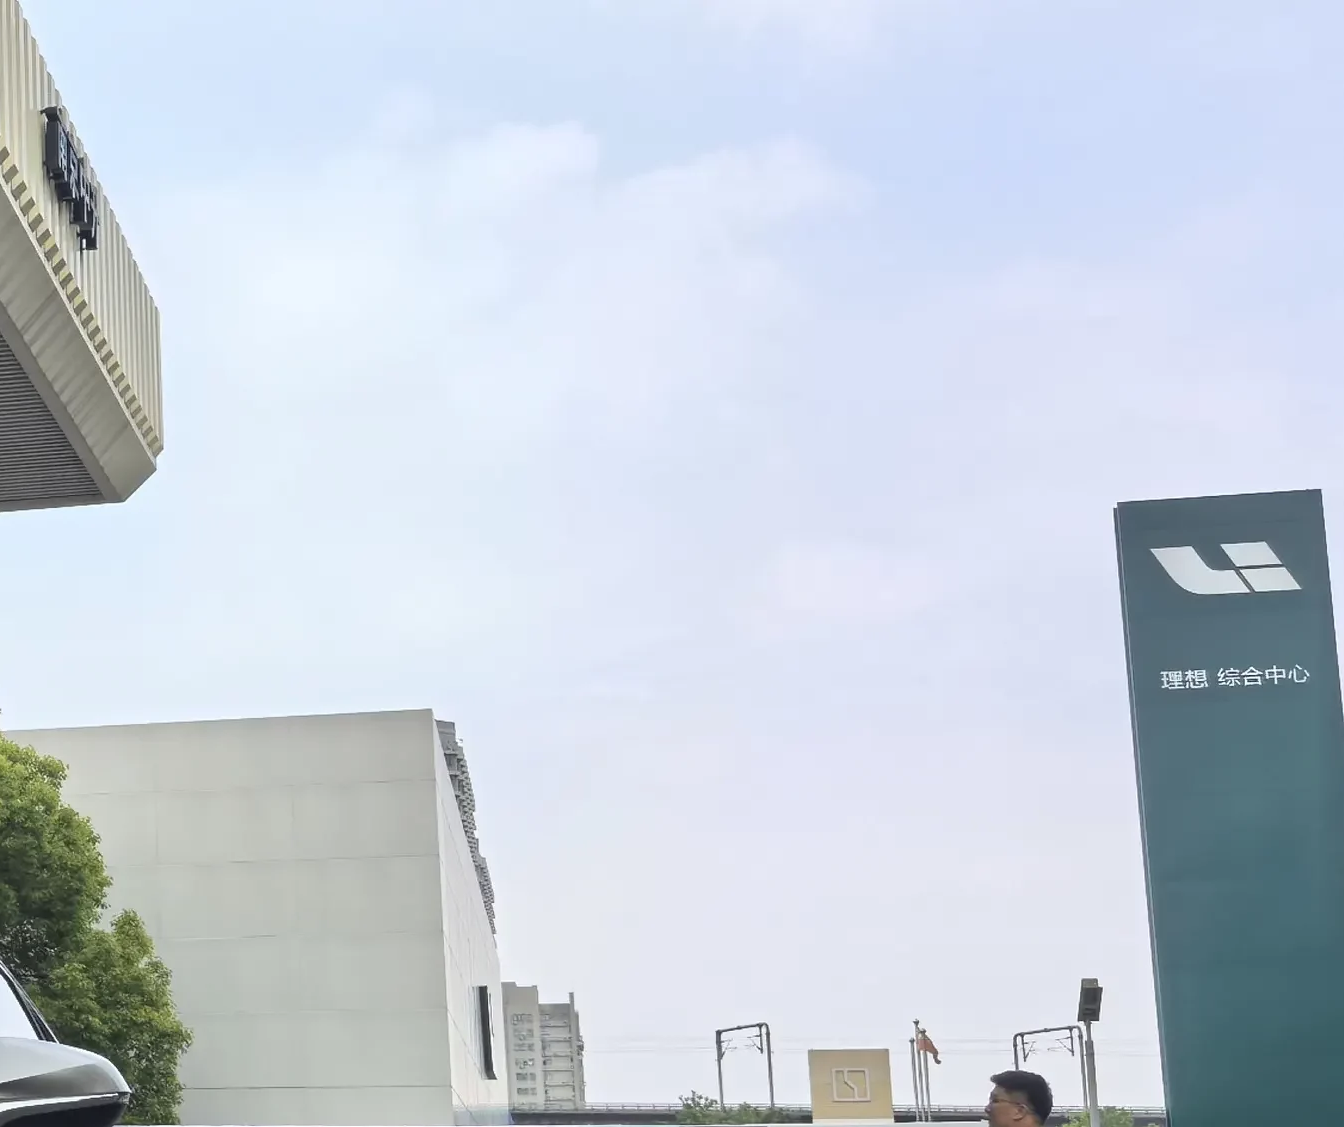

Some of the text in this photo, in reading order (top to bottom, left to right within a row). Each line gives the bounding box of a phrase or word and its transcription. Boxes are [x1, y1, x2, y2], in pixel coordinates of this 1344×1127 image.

[1160, 664, 1310, 690] 理想 综合中心
